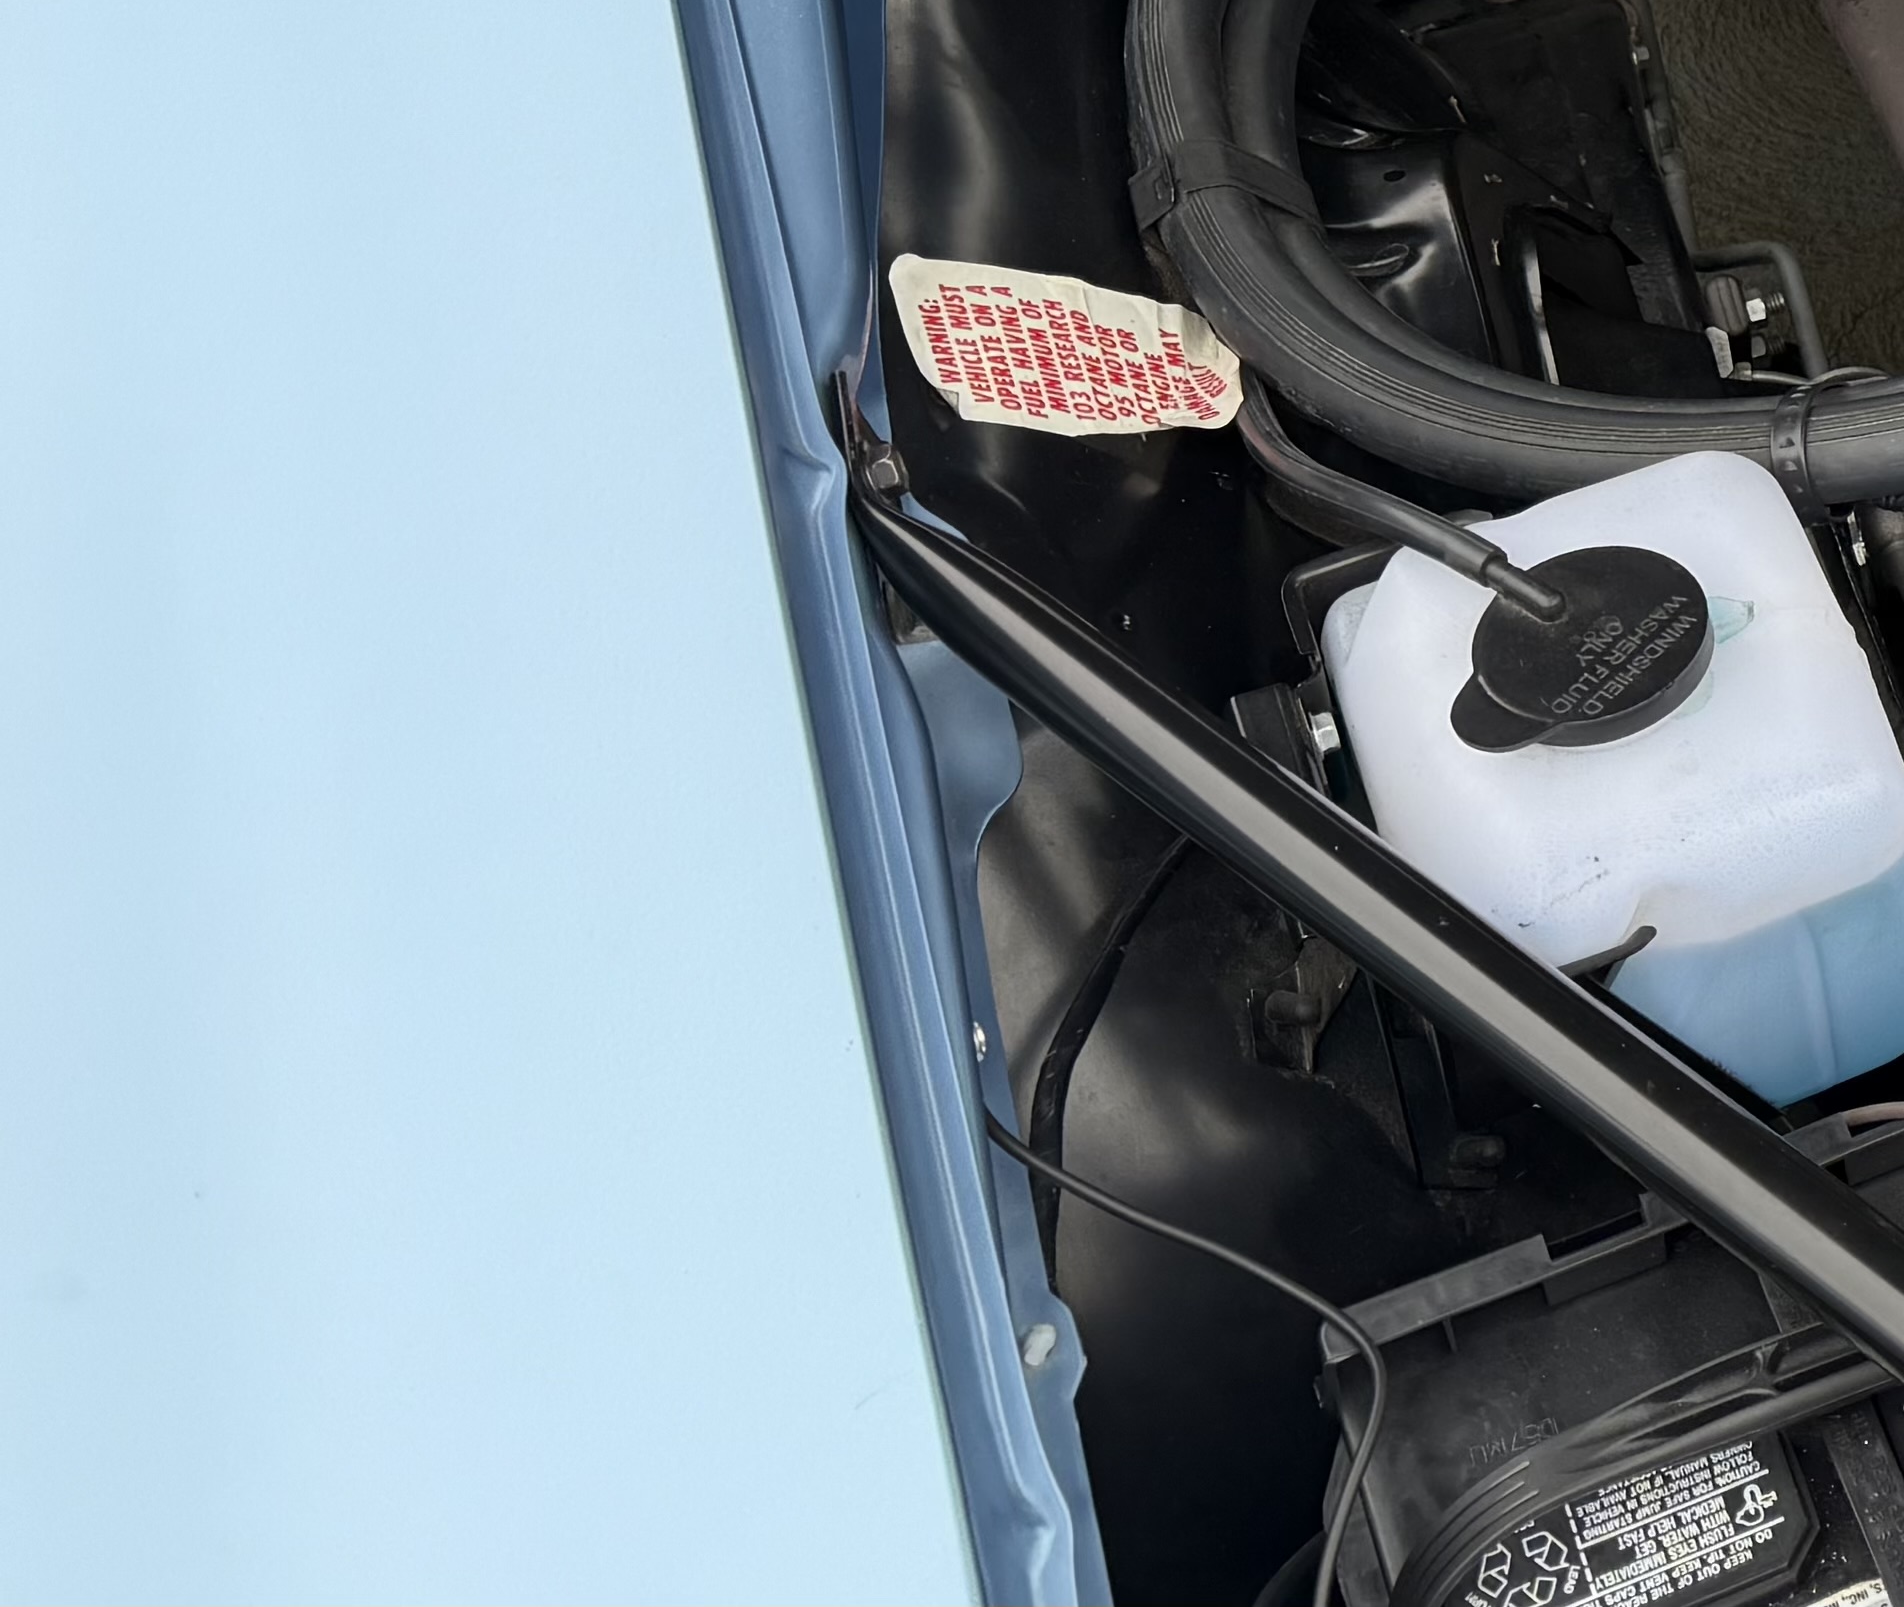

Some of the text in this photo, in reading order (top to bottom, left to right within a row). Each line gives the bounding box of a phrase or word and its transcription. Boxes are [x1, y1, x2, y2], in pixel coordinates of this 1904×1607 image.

[920, 296, 961, 383] WARNING:
[939, 285, 993, 403] VEHICLE MUST
[965, 285, 1021, 410] OPERATE ON A
[991, 286, 1046, 418] FUEL HAVING A
[1161, 331, 1184, 367] MAY
[1018, 299, 1067, 411] MINIMUM OF
[1043, 300, 1096, 420] 103 RESEARCH
[1069, 310, 1117, 420] OCTANE AND
[1094, 325, 1135, 417] 95 MOTOR
[1115, 328, 1157, 422] OCTANE OR
[1145, 346, 1176, 412] ENGINE
[1550, 595, 1687, 714] WASHER FLUID
[1575, 620, 1623, 667] ONLY
[1712, 1450, 1753, 1476] FOLLOW
[1639, 1468, 1711, 1505] INSTRUCTIONS
[1663, 1489, 1690, 1508] SAFE
[1691, 1479, 1713, 1496] FOR
[1582, 1503, 1625, 1527] VEHICLE
[1625, 1498, 1638, 1511] IN
[1634, 1500, 1661, 1520] JUMP
[1582, 1512, 1633, 1540] STARTING
[1617, 1495, 1725, 1550] MEDICAL HELP FAST
[1699, 1509, 1730, 1531] WITH
[1634, 1539, 1657, 1559] GET
[1728, 1536, 1753, 1554] NOT
[1754, 1528, 1772, 1543] DO
[1594, 1522, 1735, 1589] FLUSH EYES IMMEDIATELY
[1671, 1557, 1702, 1578] KEEP
[1722, 1549, 1753, 1569] KEEP
[1639, 1571, 1669, 1592] VENT
[1677, 1573, 1693, 1589] OF
[1696, 1562, 1720, 1581] OUT
[1604, 1585, 1636, 1605] CAPS
[1649, 1582, 1674, 1600] THE
